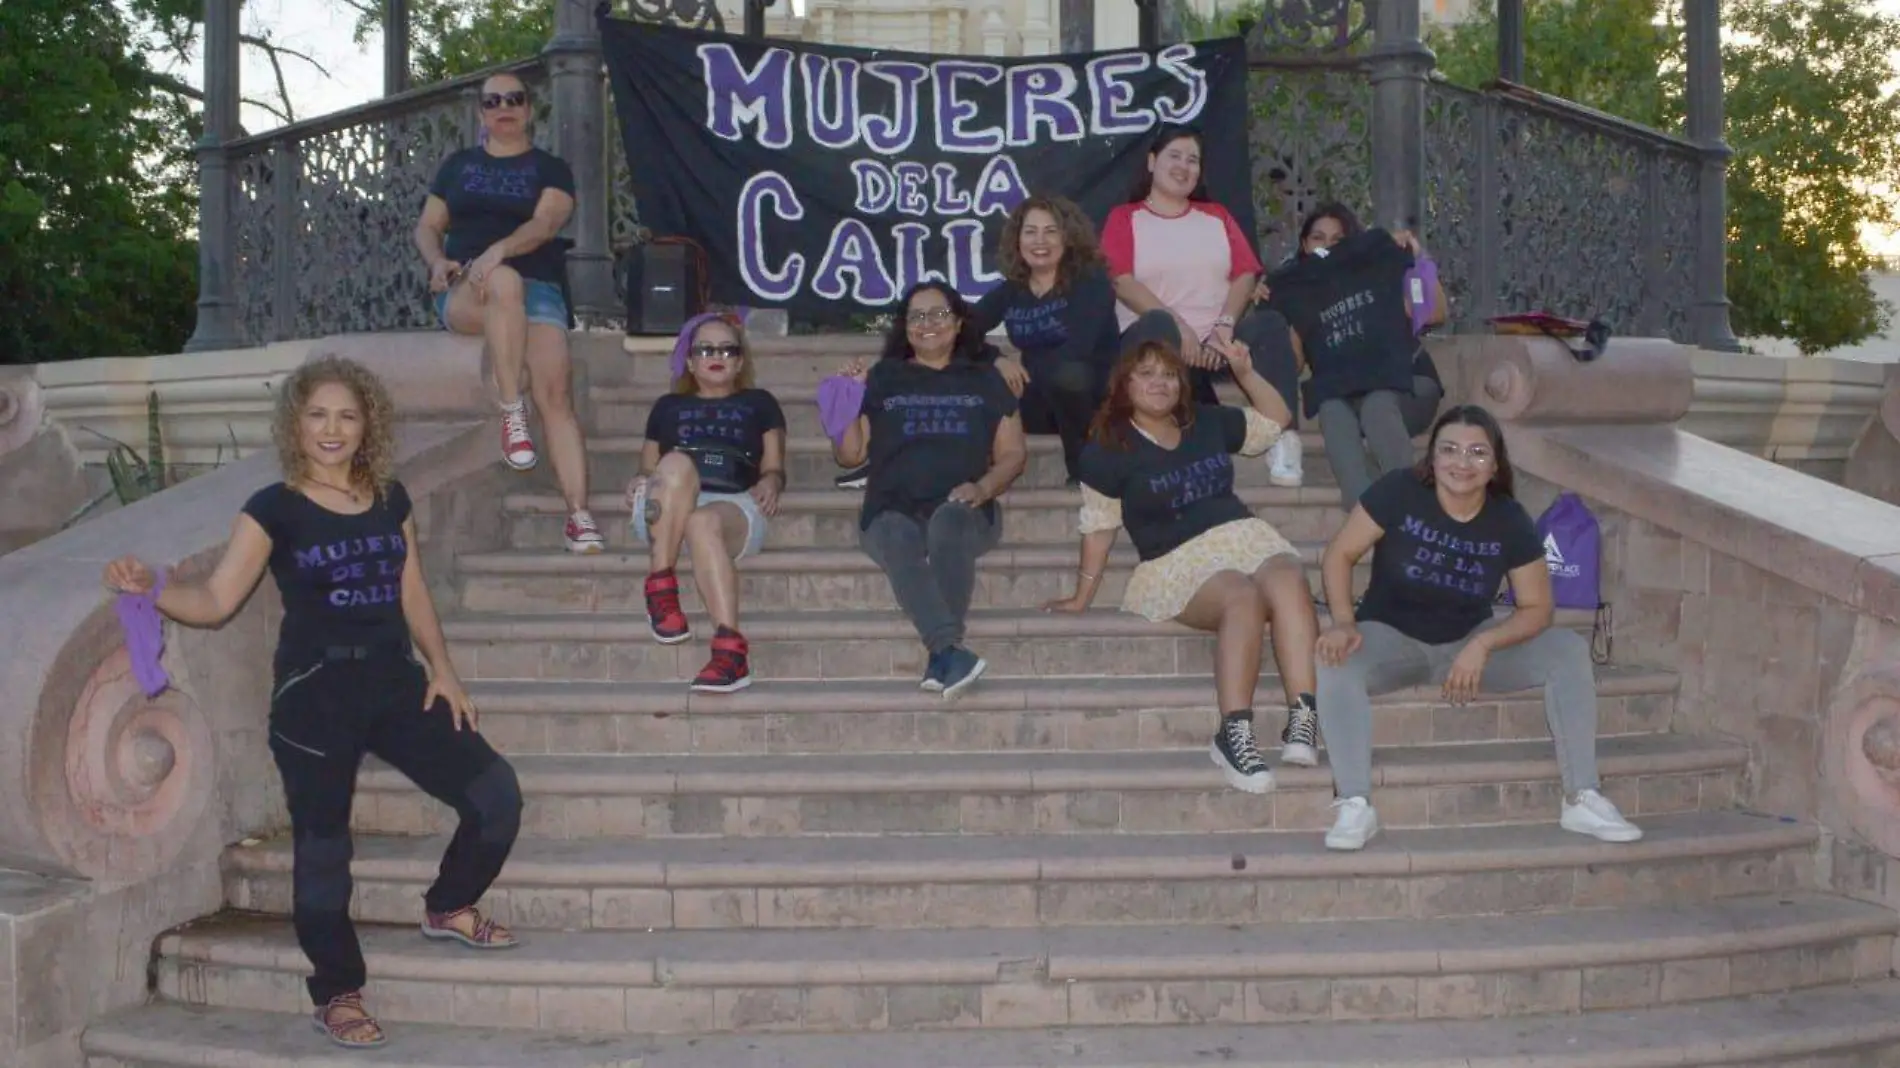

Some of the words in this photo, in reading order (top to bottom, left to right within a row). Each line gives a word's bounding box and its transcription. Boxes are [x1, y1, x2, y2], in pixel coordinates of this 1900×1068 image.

[699, 43, 1207, 152] MUJERES
[737, 171, 1006, 305] CALL
[716, 409, 743, 421] LA
[1149, 452, 1229, 494] MUJERE
[294, 533, 405, 568] MUJER
[1399, 514, 1501, 556] MUJERES
[331, 562, 365, 582] DE
[376, 560, 397, 577] L
[1415, 547, 1442, 565] DE
[1455, 558, 1485, 575] LA
[329, 584, 396, 607] CALL
[1404, 565, 1486, 595] CALLE
